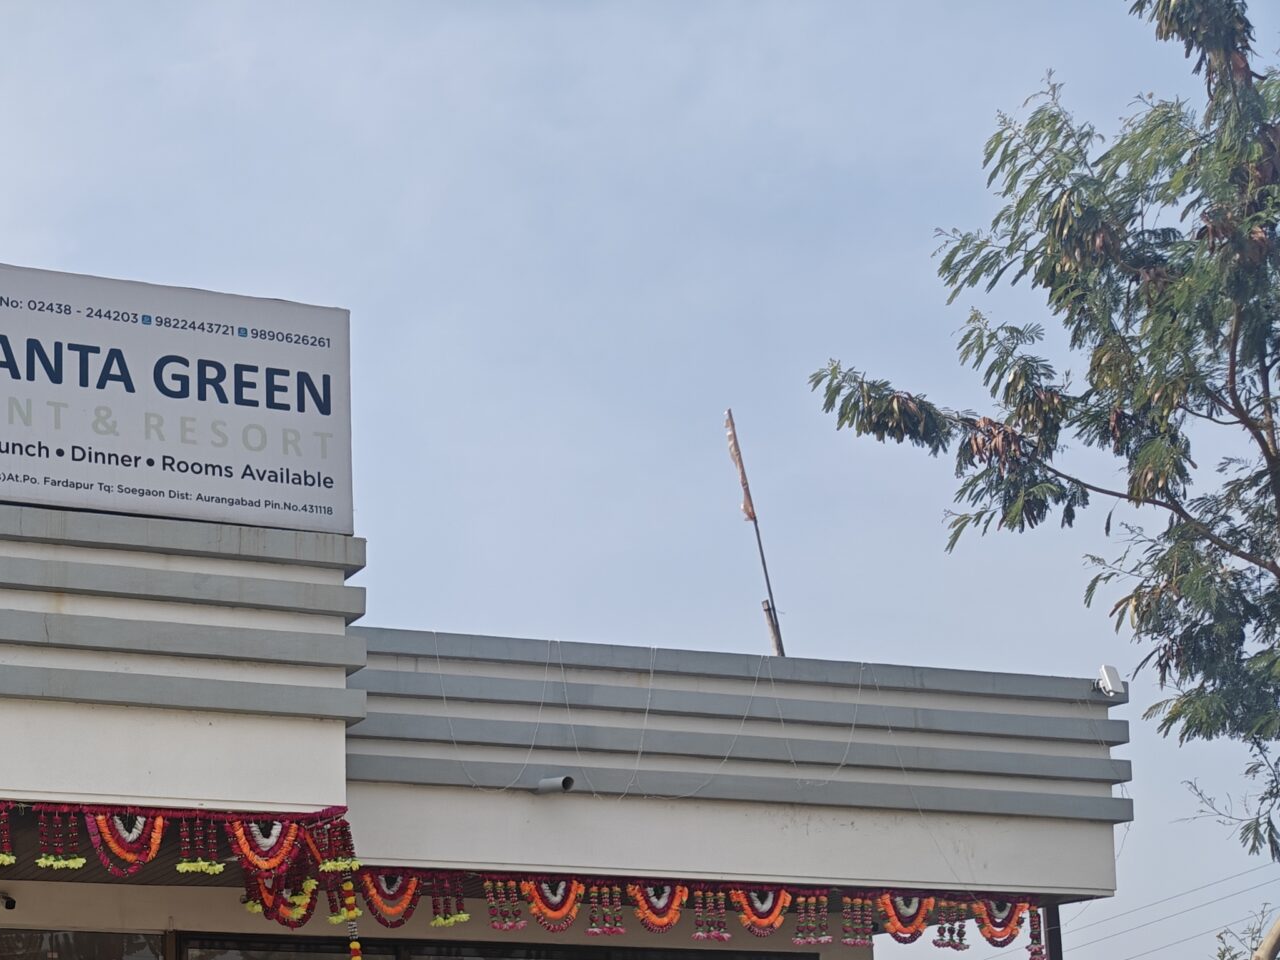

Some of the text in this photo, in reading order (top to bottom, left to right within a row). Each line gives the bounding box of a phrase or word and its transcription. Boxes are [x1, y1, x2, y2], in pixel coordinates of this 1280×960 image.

[27, 299, 72, 316] 02438
[86, 307, 139, 324] 244203
[154, 316, 235, 337] 9822443721
[250, 328, 331, 349] 9890626261
[153, 354, 331, 416] GREEN
[91, 405, 120, 437] &
[143, 412, 333, 460] RESORT
[71, 446, 141, 468] Dinner
[162, 456, 234, 478] Rooms
[240, 463, 334, 489] Available
[43, 477, 94, 494] Fardapur
[97, 484, 114, 494] Tq:
[117, 484, 165, 500] Soegaon
[168, 489, 193, 501] Dist:
[196, 493, 261, 511] Aurangabad
